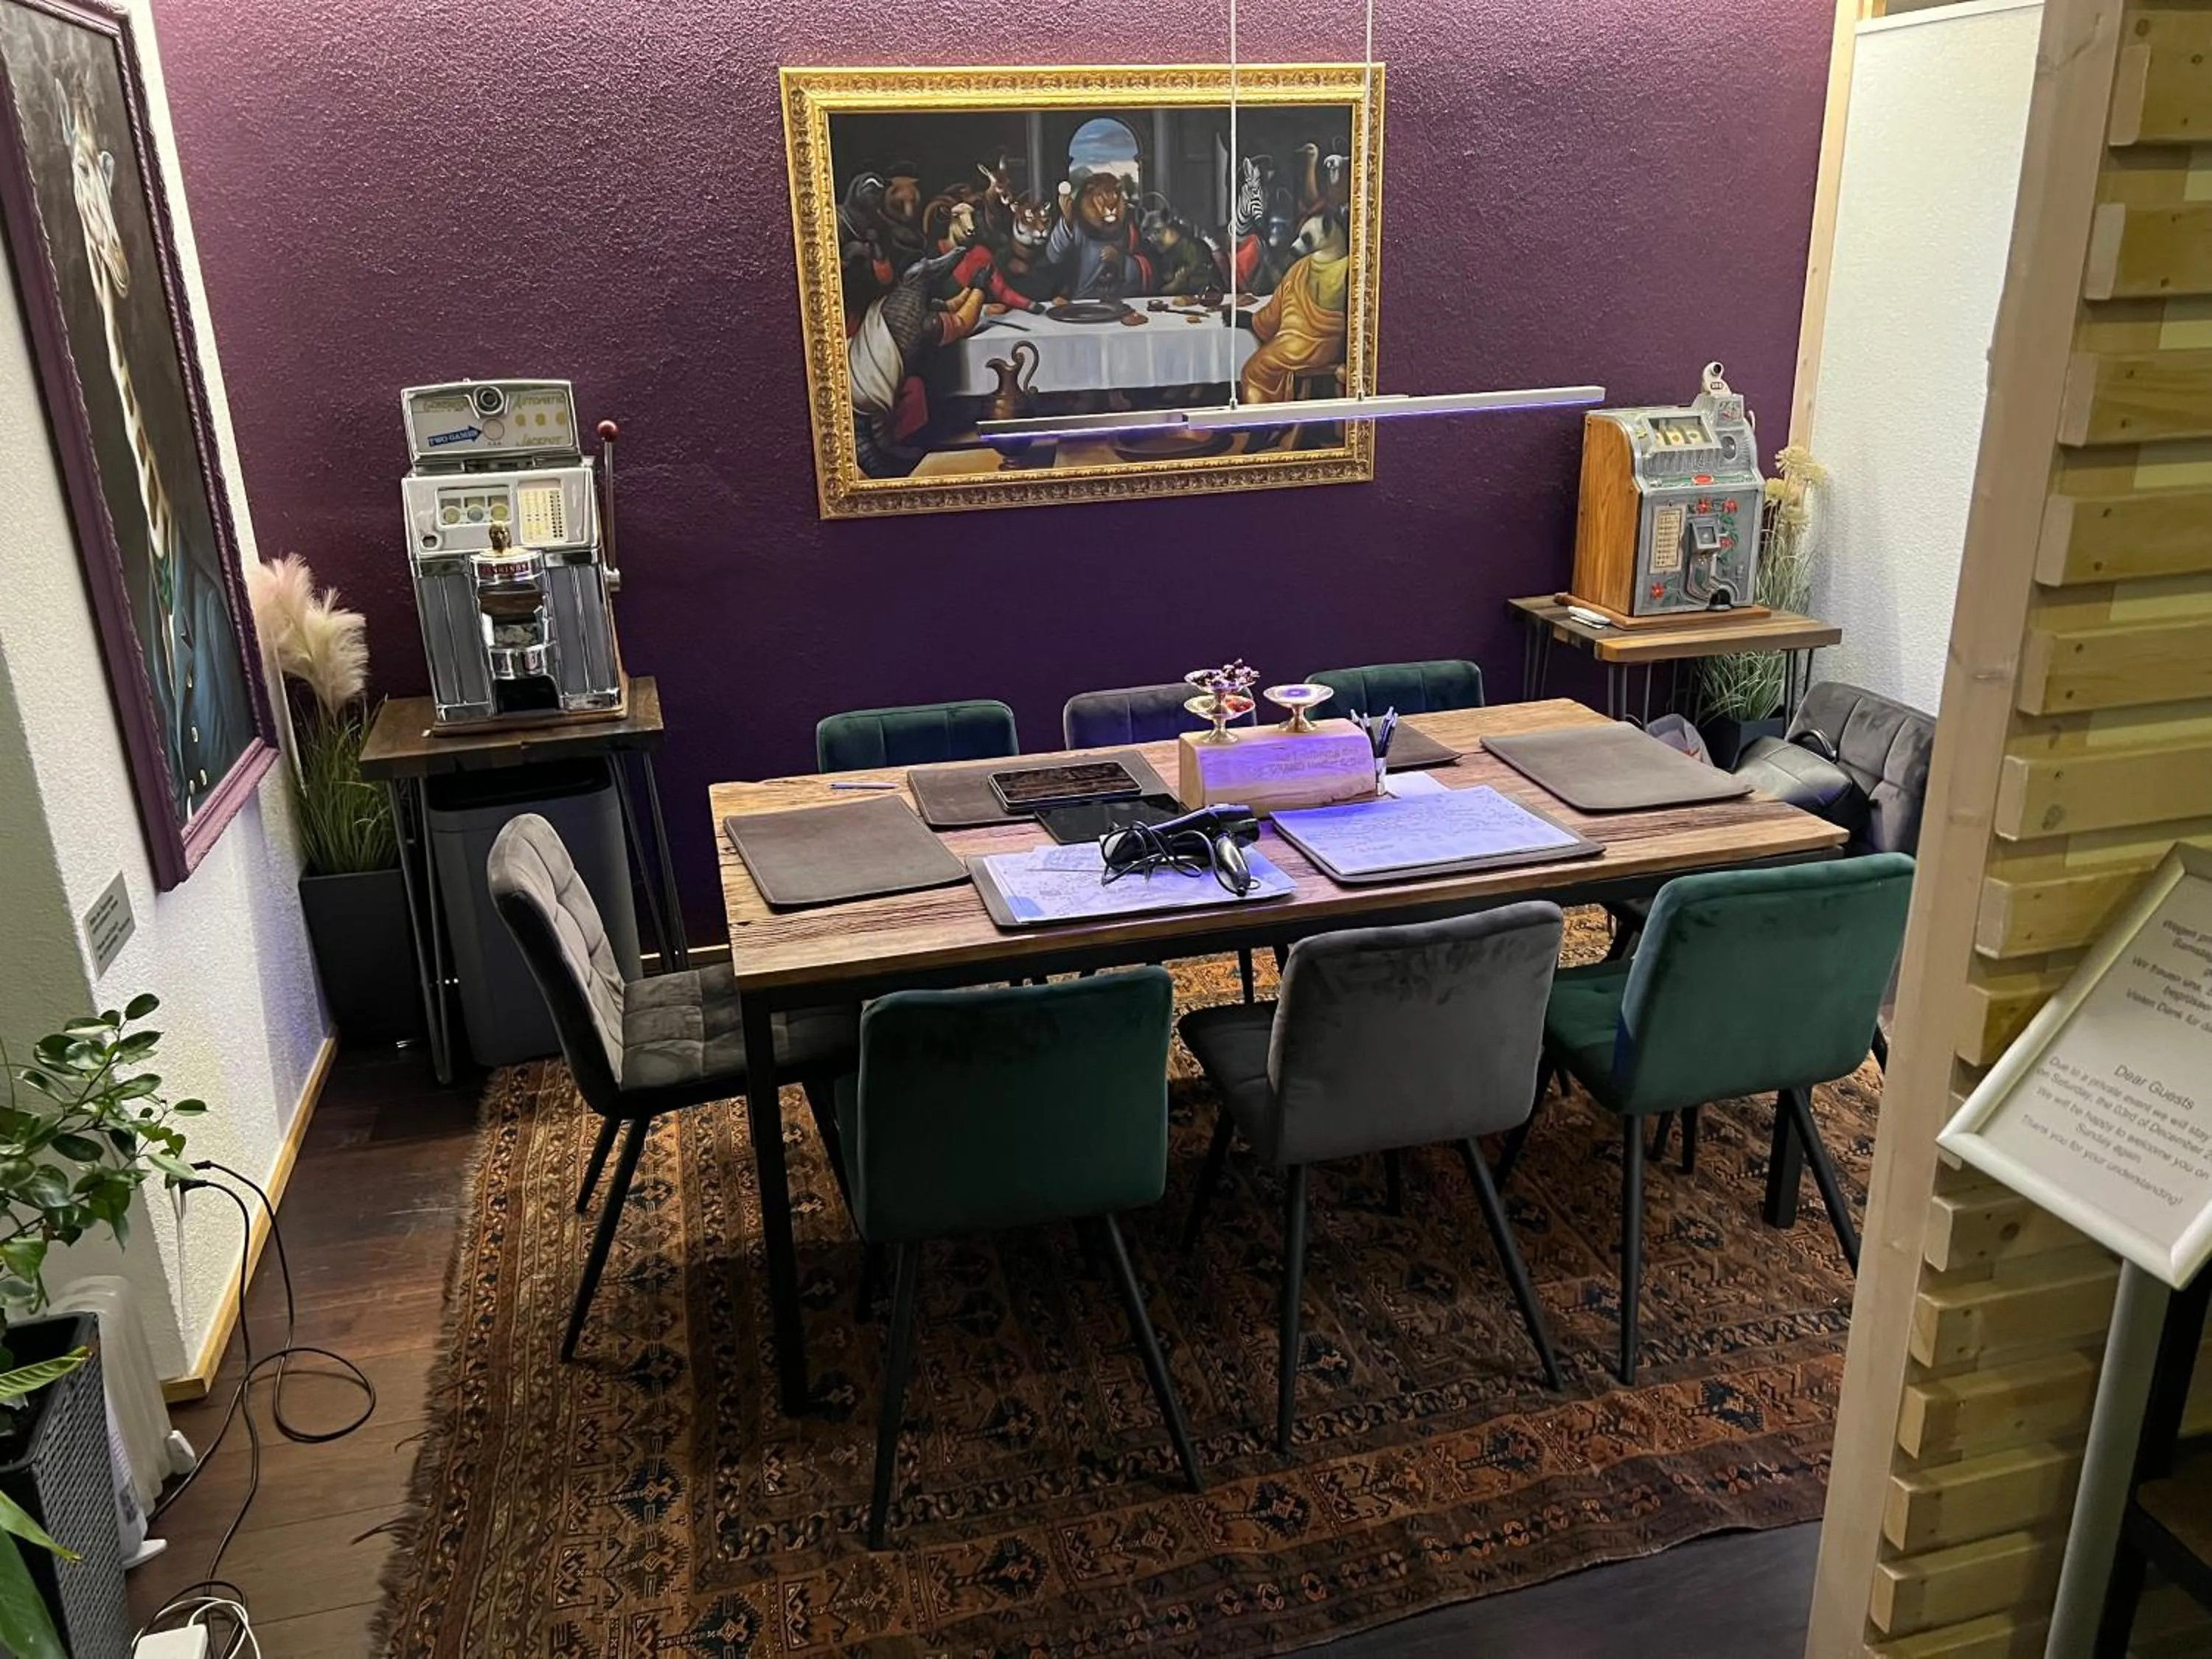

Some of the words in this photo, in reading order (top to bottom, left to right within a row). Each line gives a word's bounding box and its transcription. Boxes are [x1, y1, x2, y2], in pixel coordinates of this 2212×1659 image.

[2114, 1064, 2147, 1086] Dear
[2149, 1081, 2194, 1110] Guests
[2149, 1122, 2205, 1155] December
